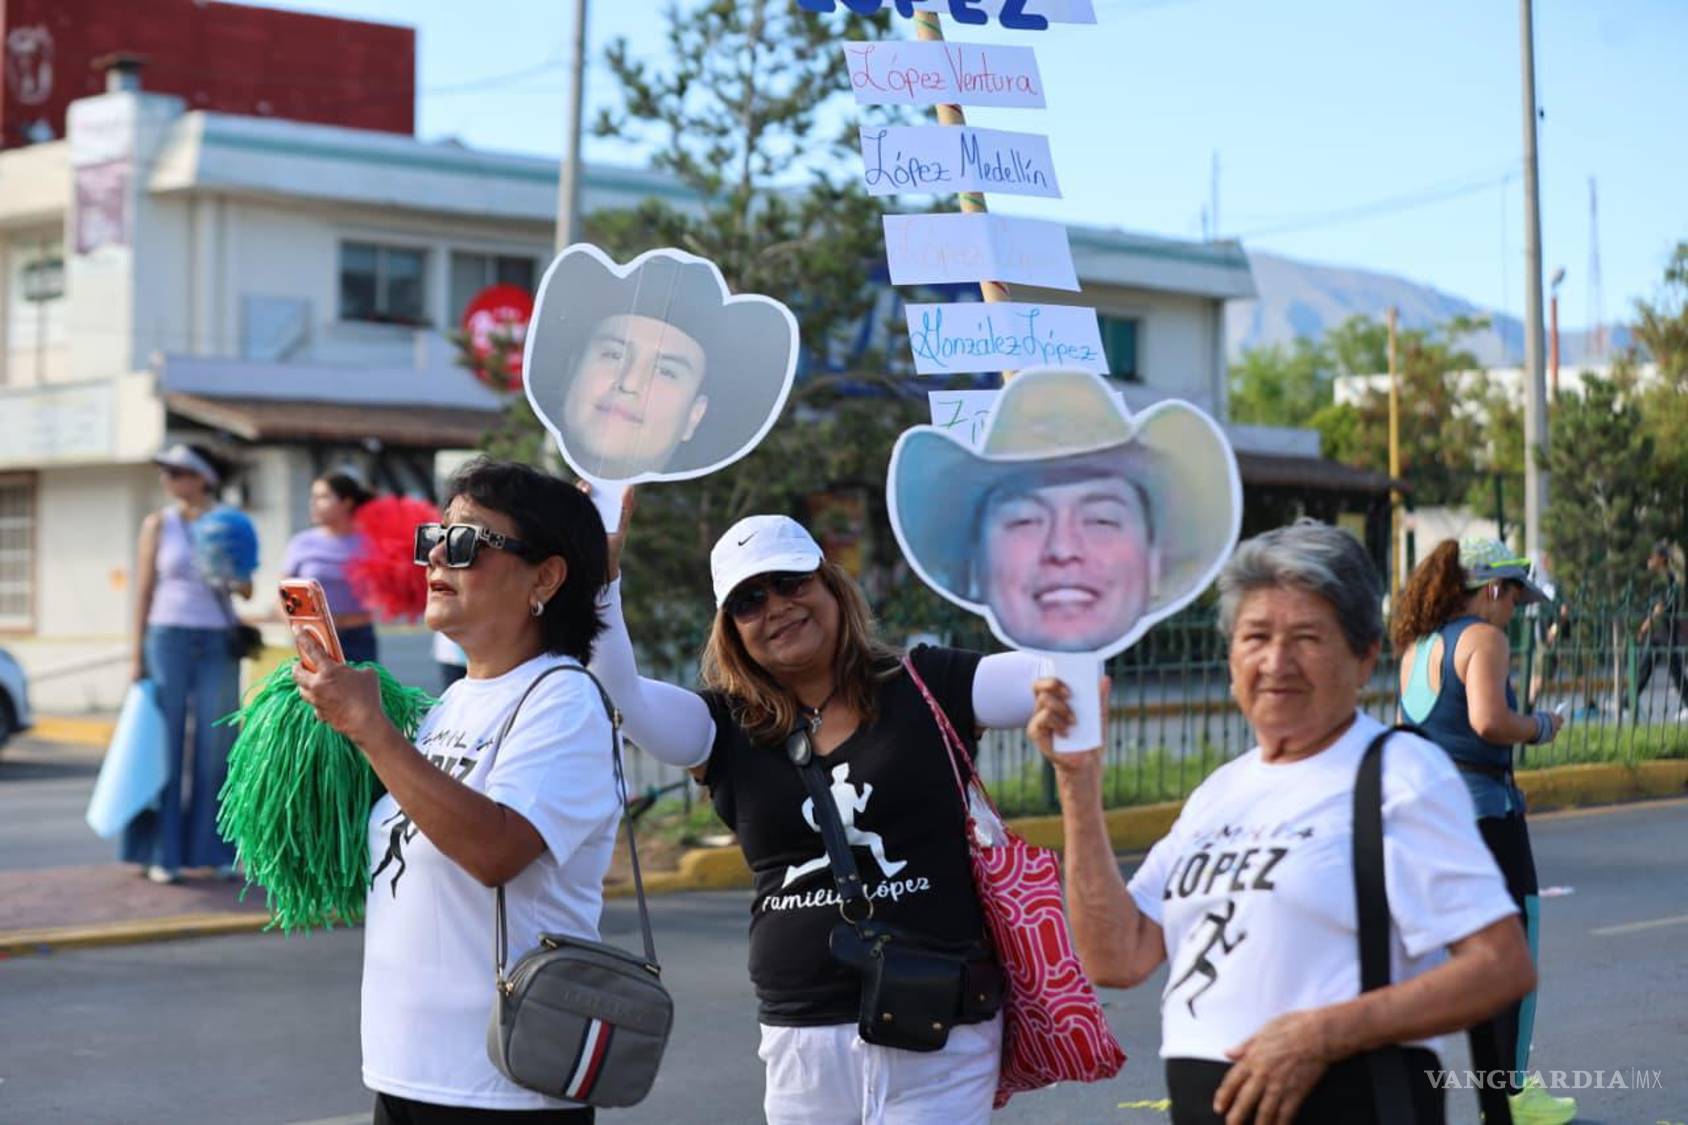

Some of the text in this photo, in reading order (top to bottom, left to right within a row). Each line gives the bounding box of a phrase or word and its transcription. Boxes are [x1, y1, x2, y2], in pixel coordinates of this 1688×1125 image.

[849, 45, 1038, 98] López Ventura
[863, 130, 1048, 187] López Medellín
[1016, 308, 1098, 365] López
[761, 888, 844, 912] amili
